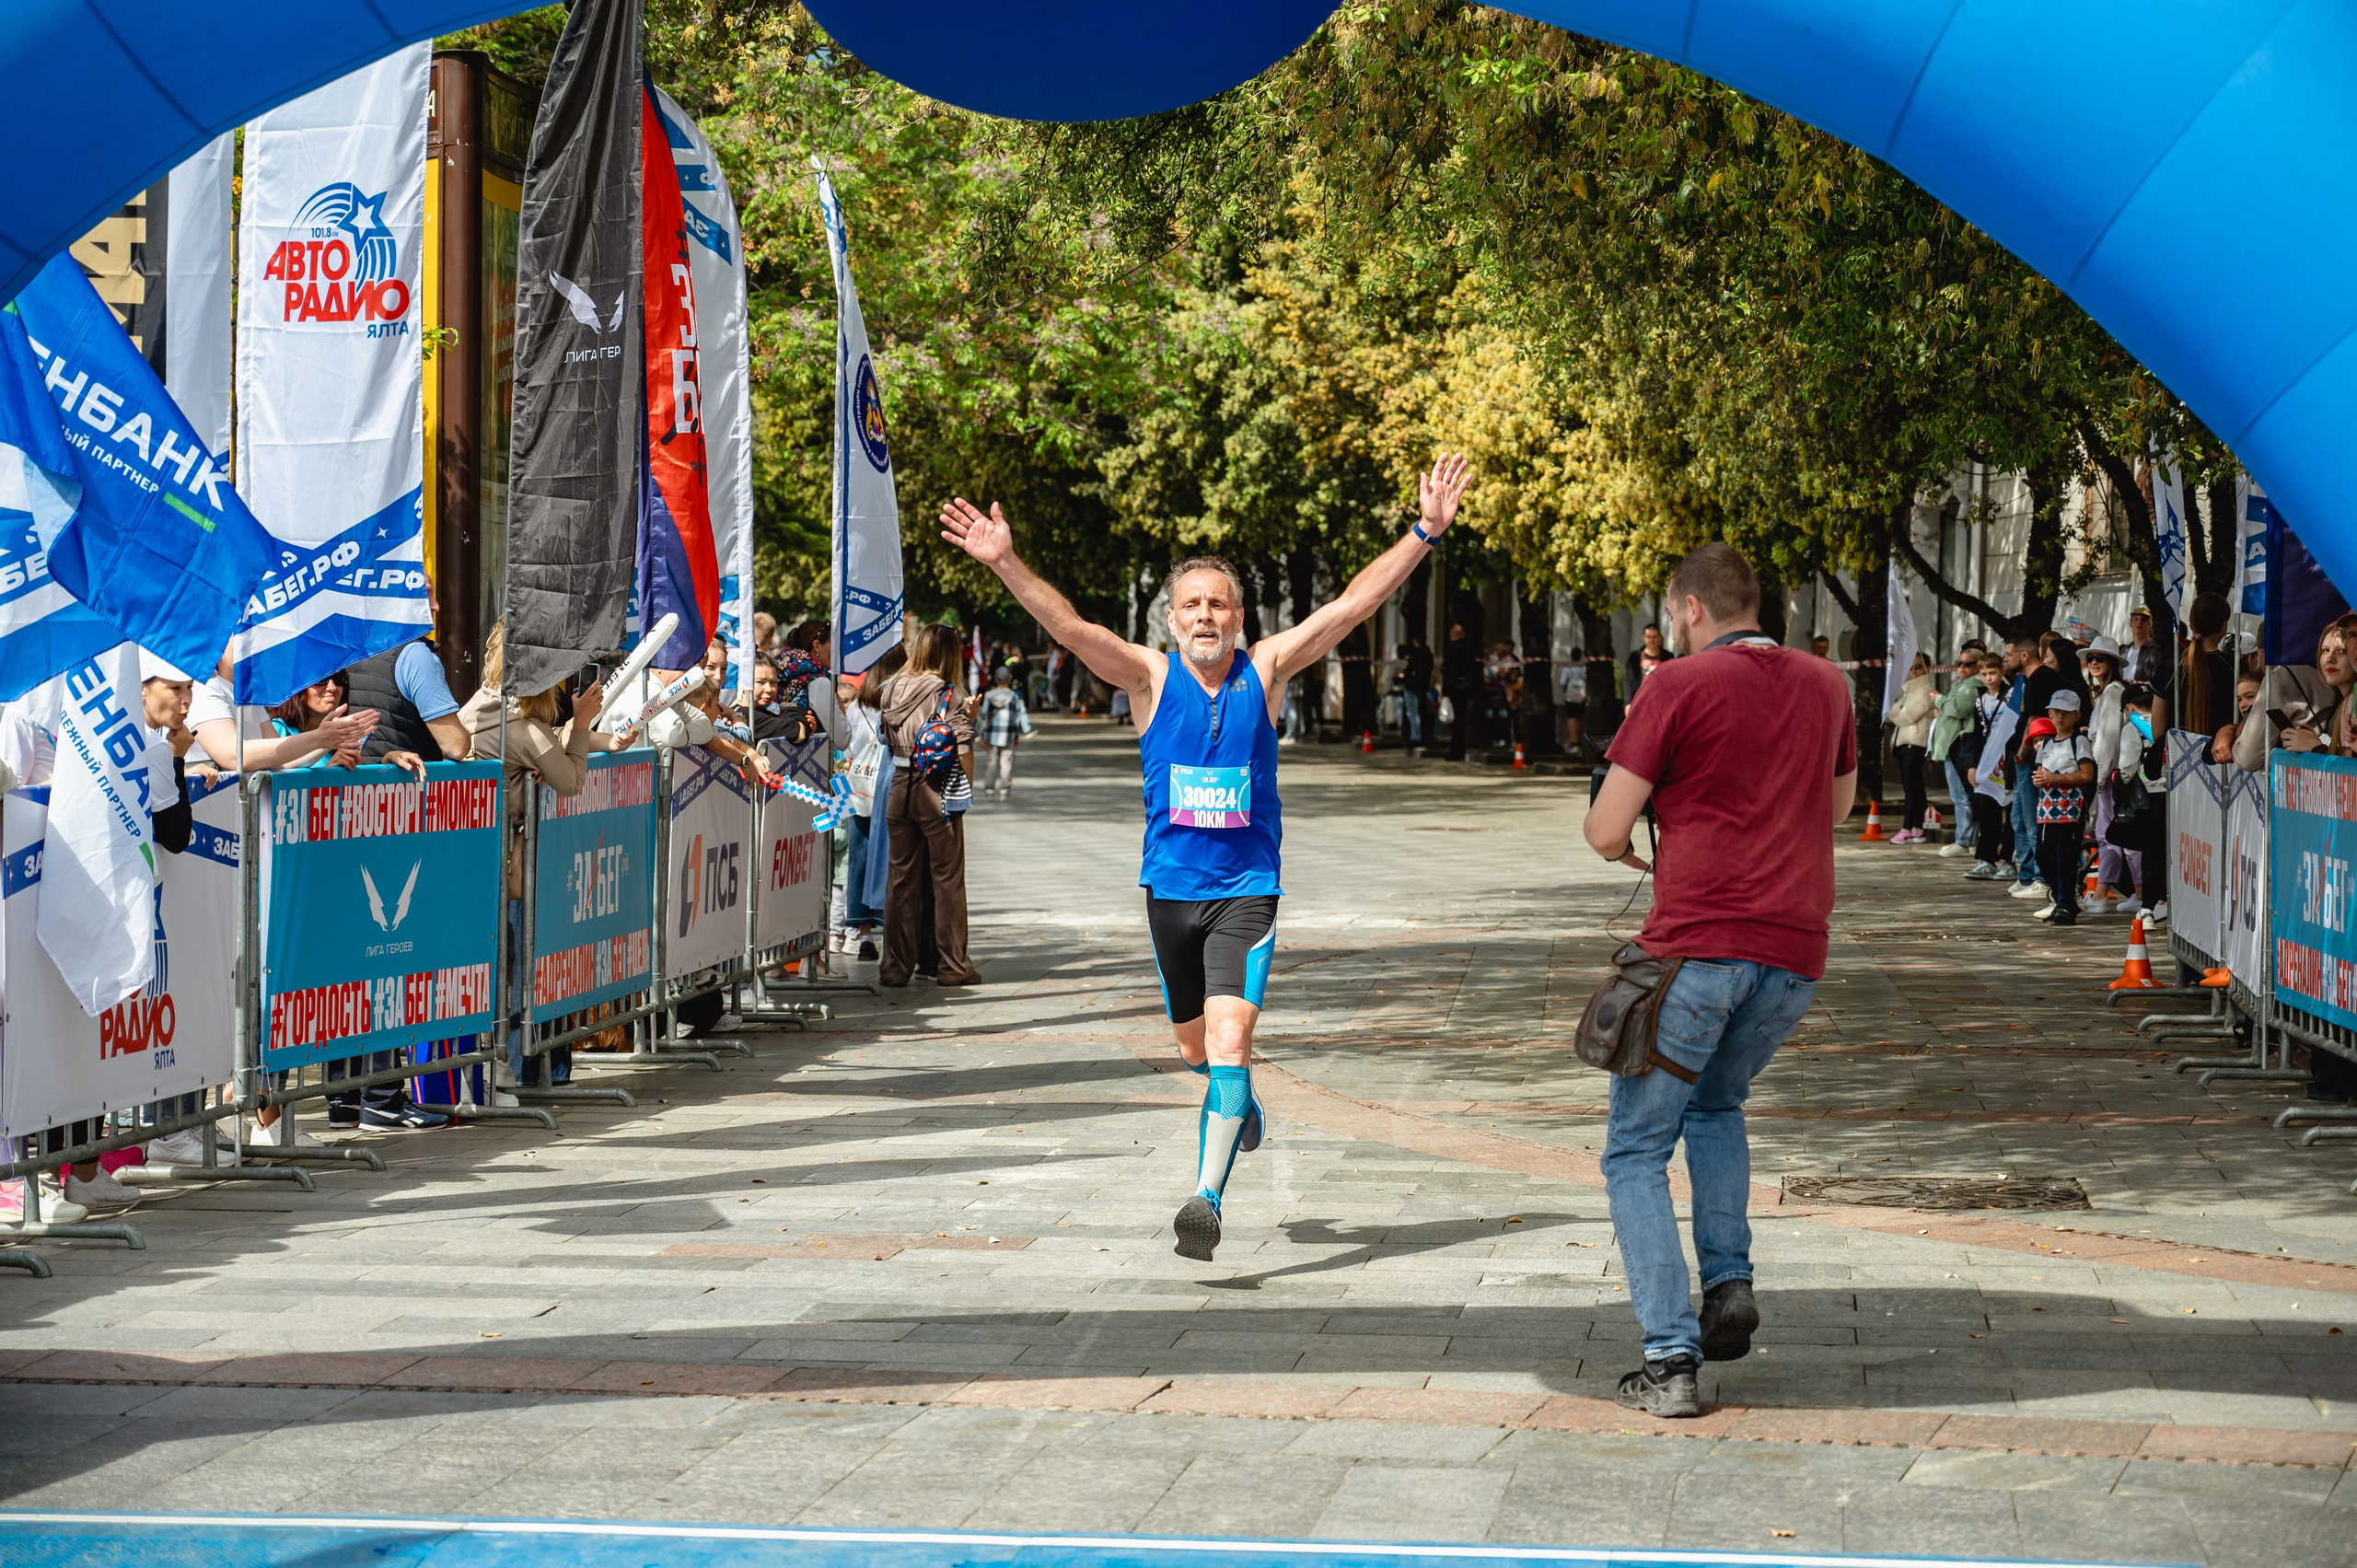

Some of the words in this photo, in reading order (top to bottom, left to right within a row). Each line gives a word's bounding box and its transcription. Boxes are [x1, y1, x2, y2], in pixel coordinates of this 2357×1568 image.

[311, 227, 331, 238] 101.8
[263, 239, 350, 281] АВТО
[284, 279, 410, 322] РАДИО
[367, 321, 409, 338] ЯЛТА
[564, 350, 597, 363] ЛИГА
[91, 445, 159, 494] ПАРТНЕР
[237, 540, 360, 625] АБЕГ.РФ
[66, 657, 152, 819] ЕНБА
[97, 775, 142, 838] ПАРТНЕР
[341, 782, 424, 839] #ВОСТОРГ
[425, 779, 497, 832] #МОМЕНТ
[1183, 785, 1237, 808] 30024
[1193, 810, 1225, 829] 10KM
[704, 842, 738, 915] ПСБ
[771, 831, 816, 892] FONBET
[2179, 831, 2212, 898] FONBET
[366, 945, 384, 957] ЛИГА
[386, 941, 412, 954] ГЕРОЕВ
[99, 993, 175, 1061] РАДИО
[269, 980, 372, 1051] #ГОРДОСТЬ
[435, 962, 491, 1020] #МЕЧТА
[155, 1049, 175, 1070] ЯЛТА
